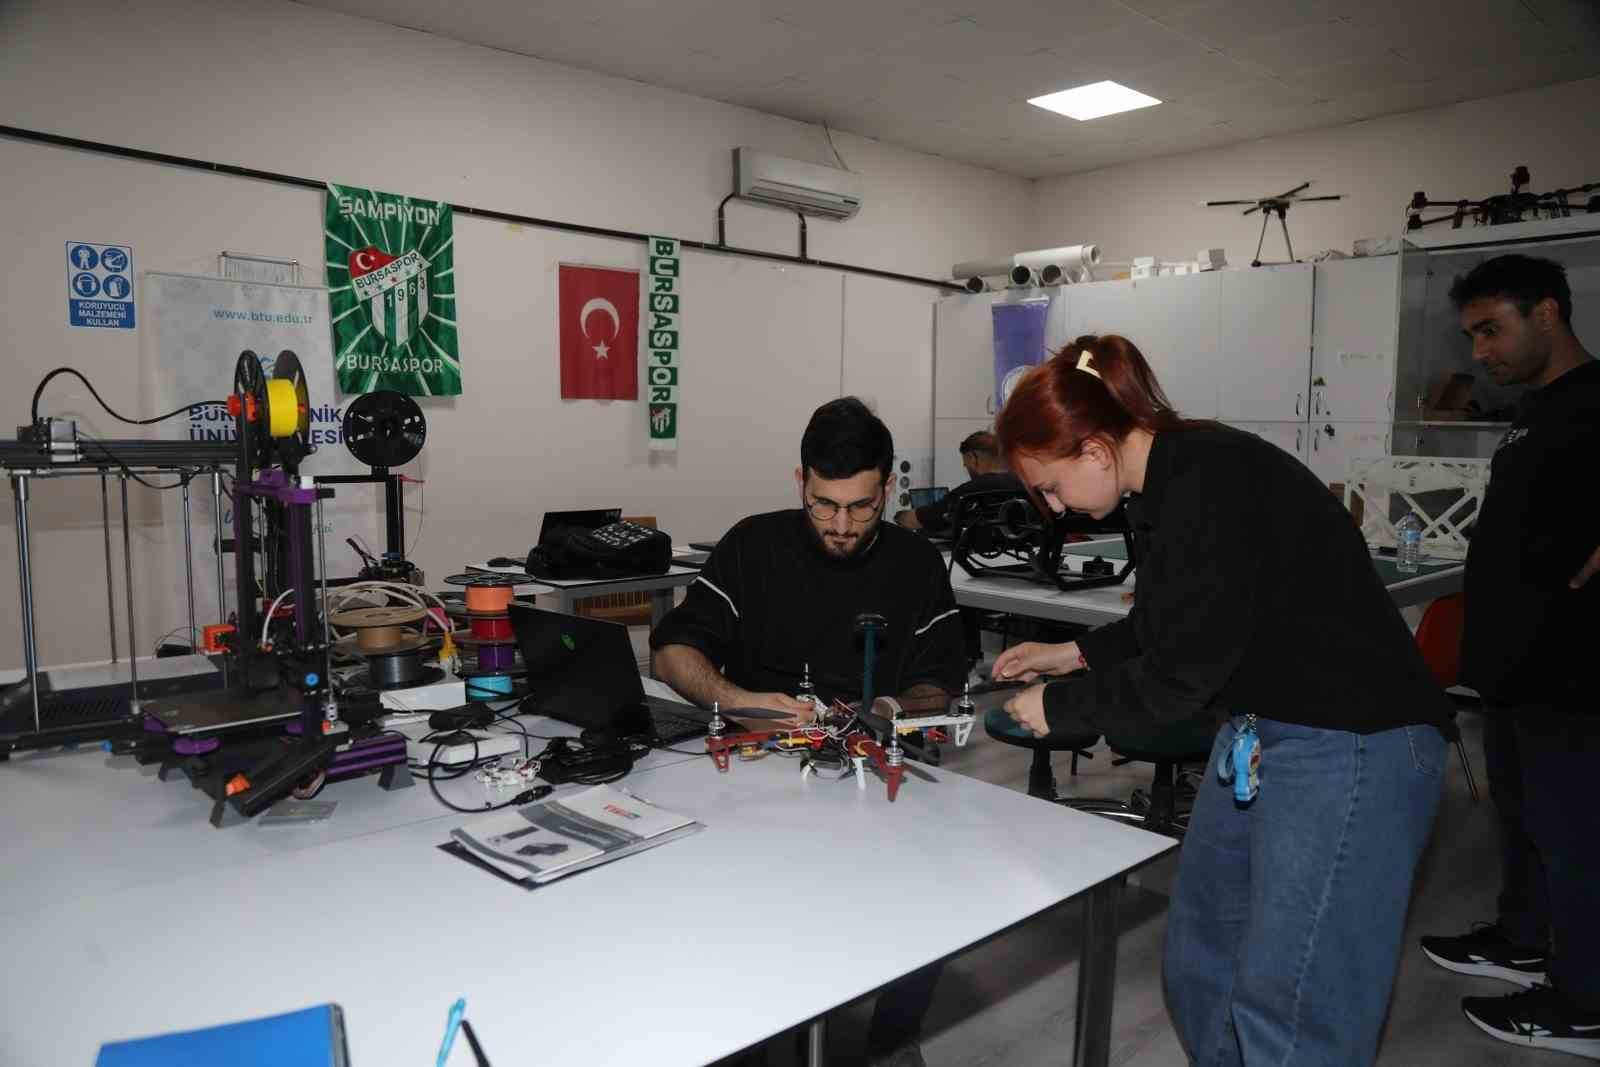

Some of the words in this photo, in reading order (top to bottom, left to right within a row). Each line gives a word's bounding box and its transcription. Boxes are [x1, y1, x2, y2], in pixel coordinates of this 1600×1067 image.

[355, 252, 420, 289] BURSASPOR
[79, 301, 125, 311] KORUYUCU
[214, 310, 313, 325] www.btu.edu.tr
[653, 239, 675, 402] BURSASPOR
[346, 353, 444, 374] BURSASPOR
